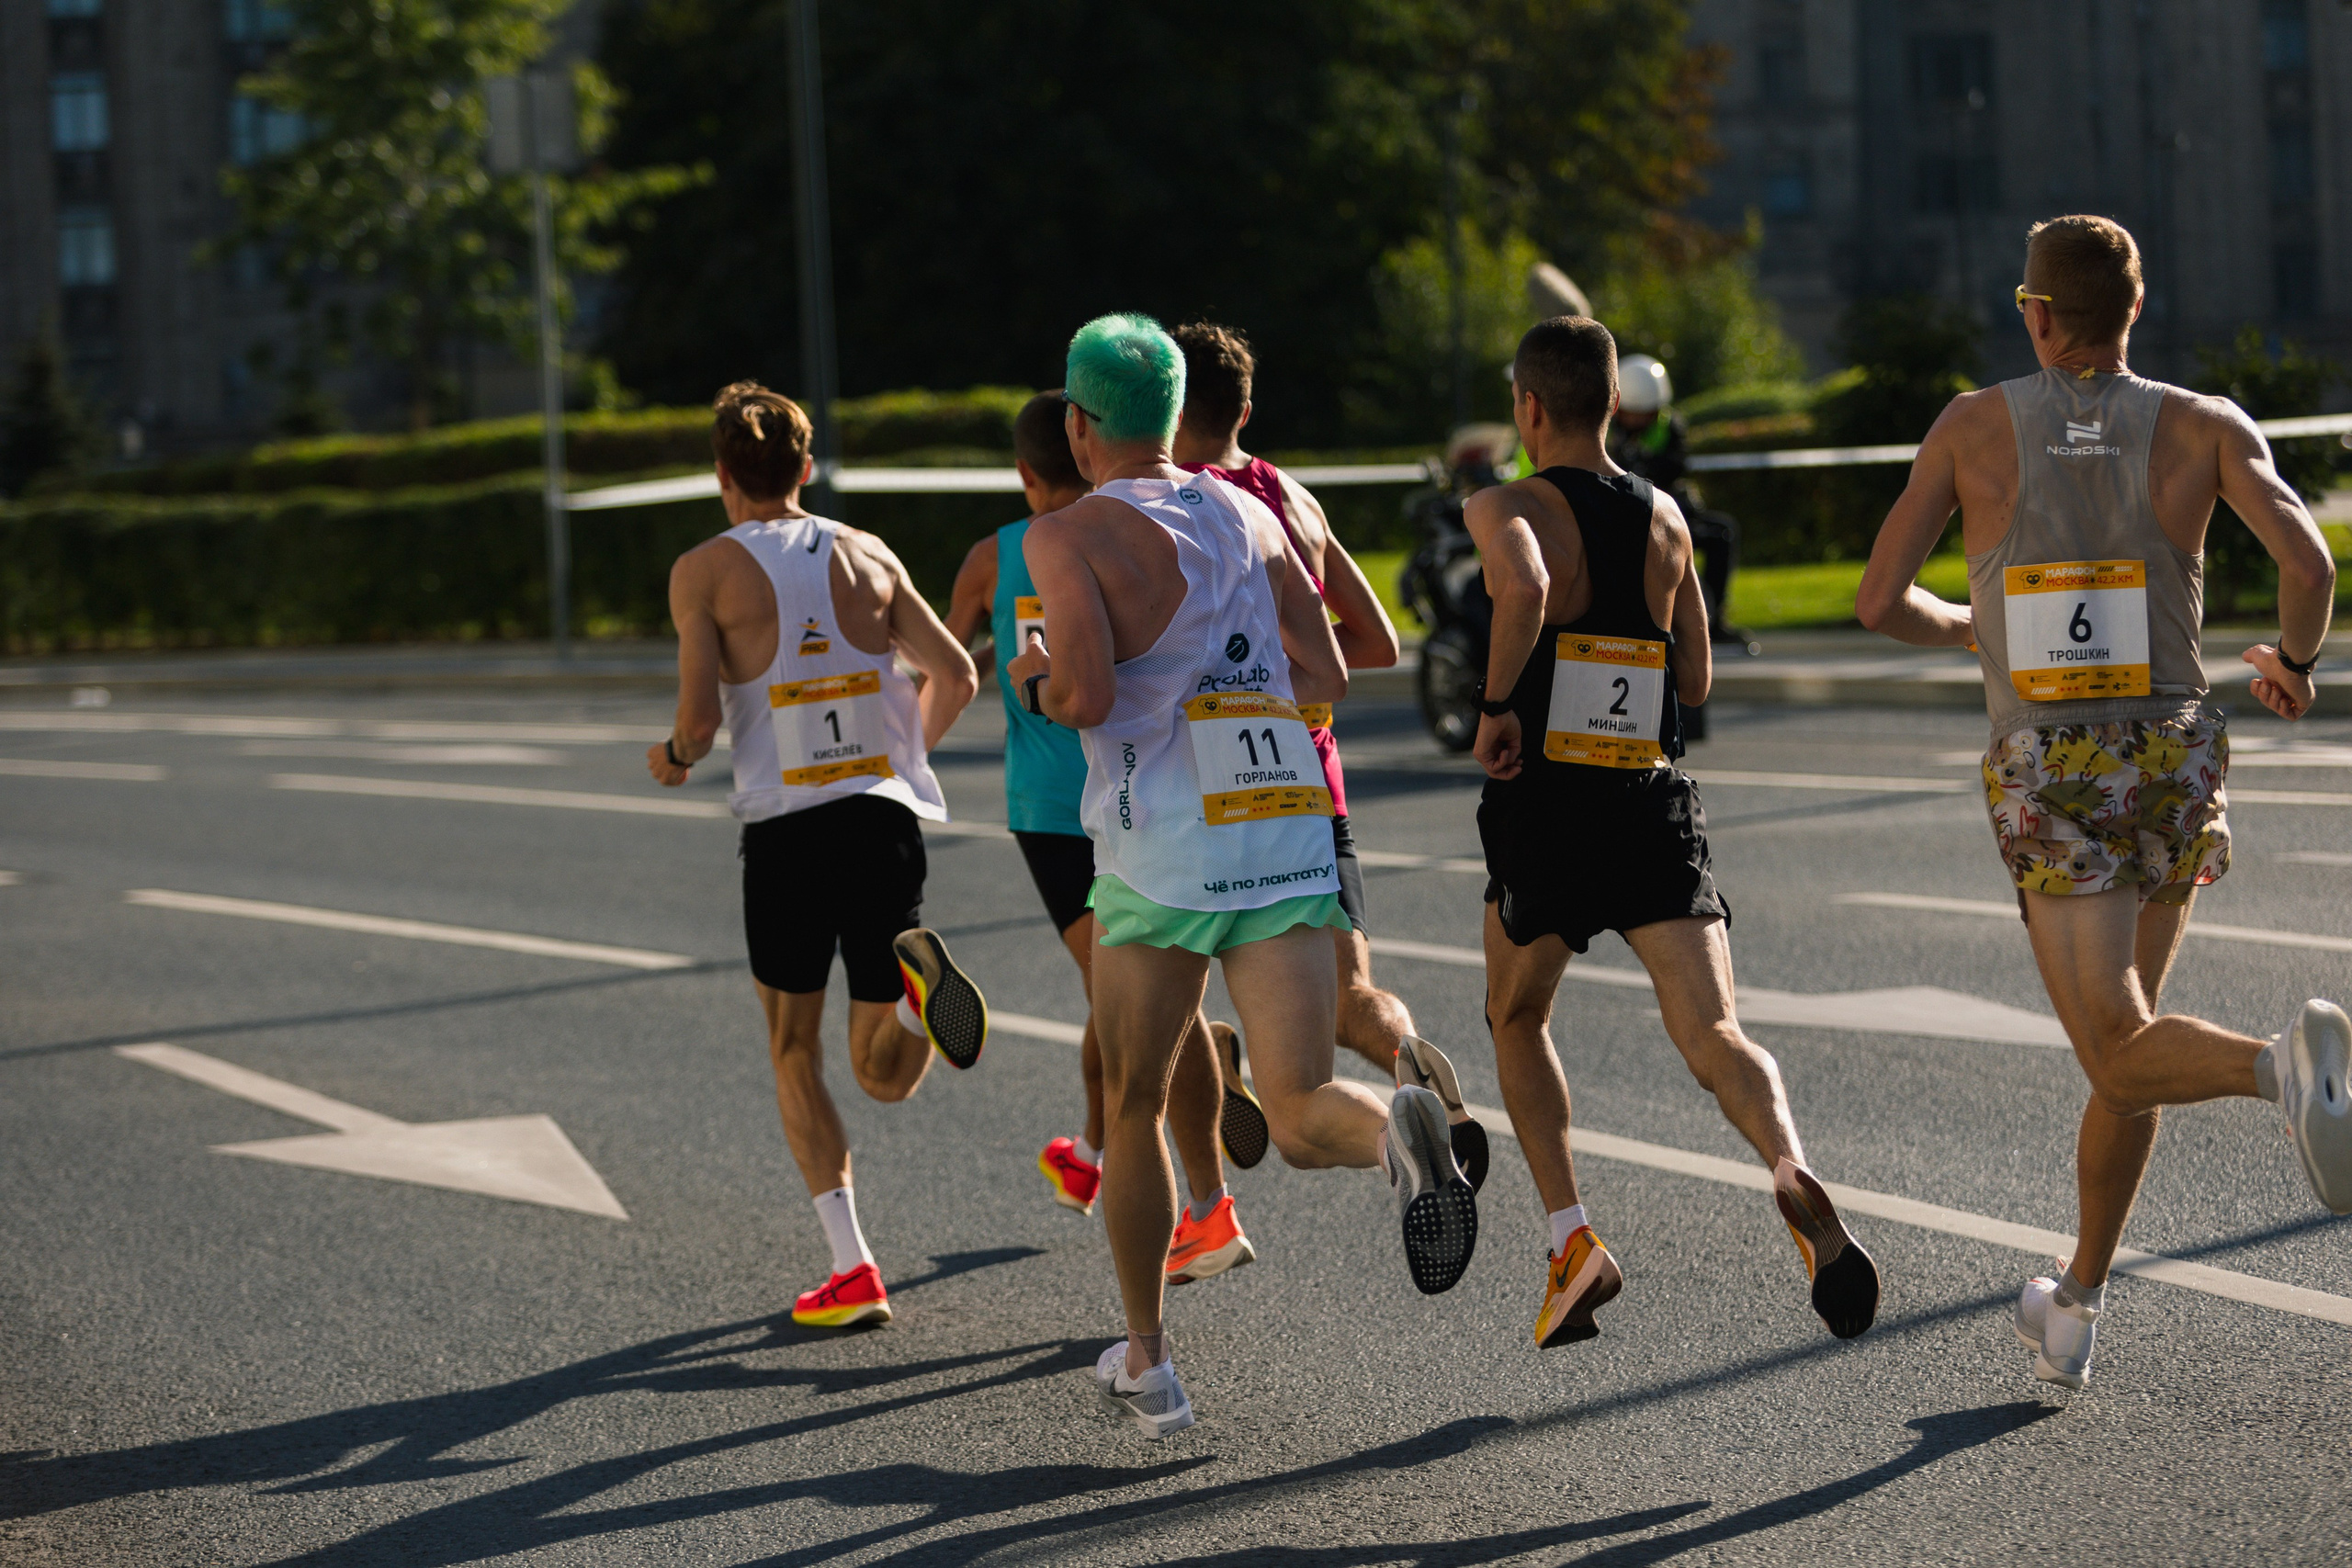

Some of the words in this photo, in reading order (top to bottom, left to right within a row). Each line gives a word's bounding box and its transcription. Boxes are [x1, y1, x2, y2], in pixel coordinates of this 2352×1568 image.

[2046, 446, 2120, 456] NORDSKI
[2045, 566, 2096, 578] МАРАФОН
[2046, 576, 2089, 587] МОСКВА
[2097, 576, 2117, 585] 42,2
[2118, 575, 2133, 584] КМ
[2069, 602, 2092, 643] 6
[800, 642, 828, 654] PRO
[1596, 641, 1637, 652] МАРАФОН
[1596, 650, 1632, 661] МОСКВА
[1636, 654, 1648, 663] 42,2
[1648, 655, 1658, 664] КМ
[2047, 648, 2109, 662] ТРОШКИН
[1197, 663, 1270, 692] ProLab
[1220, 696, 1266, 706] МАРАФОН
[1609, 676, 1629, 716] 2
[1223, 705, 1261, 714] МОСКВА
[825, 709, 841, 743] 1
[1588, 717, 1637, 733] МИНШИН
[813, 744, 863, 761] КИСЕЛЁВ
[1238, 728, 1282, 766] 11
[1235, 771, 1298, 784] ГОРЛАНОВ
[1204, 880, 1228, 894] Чё
[1232, 878, 1255, 891] по
